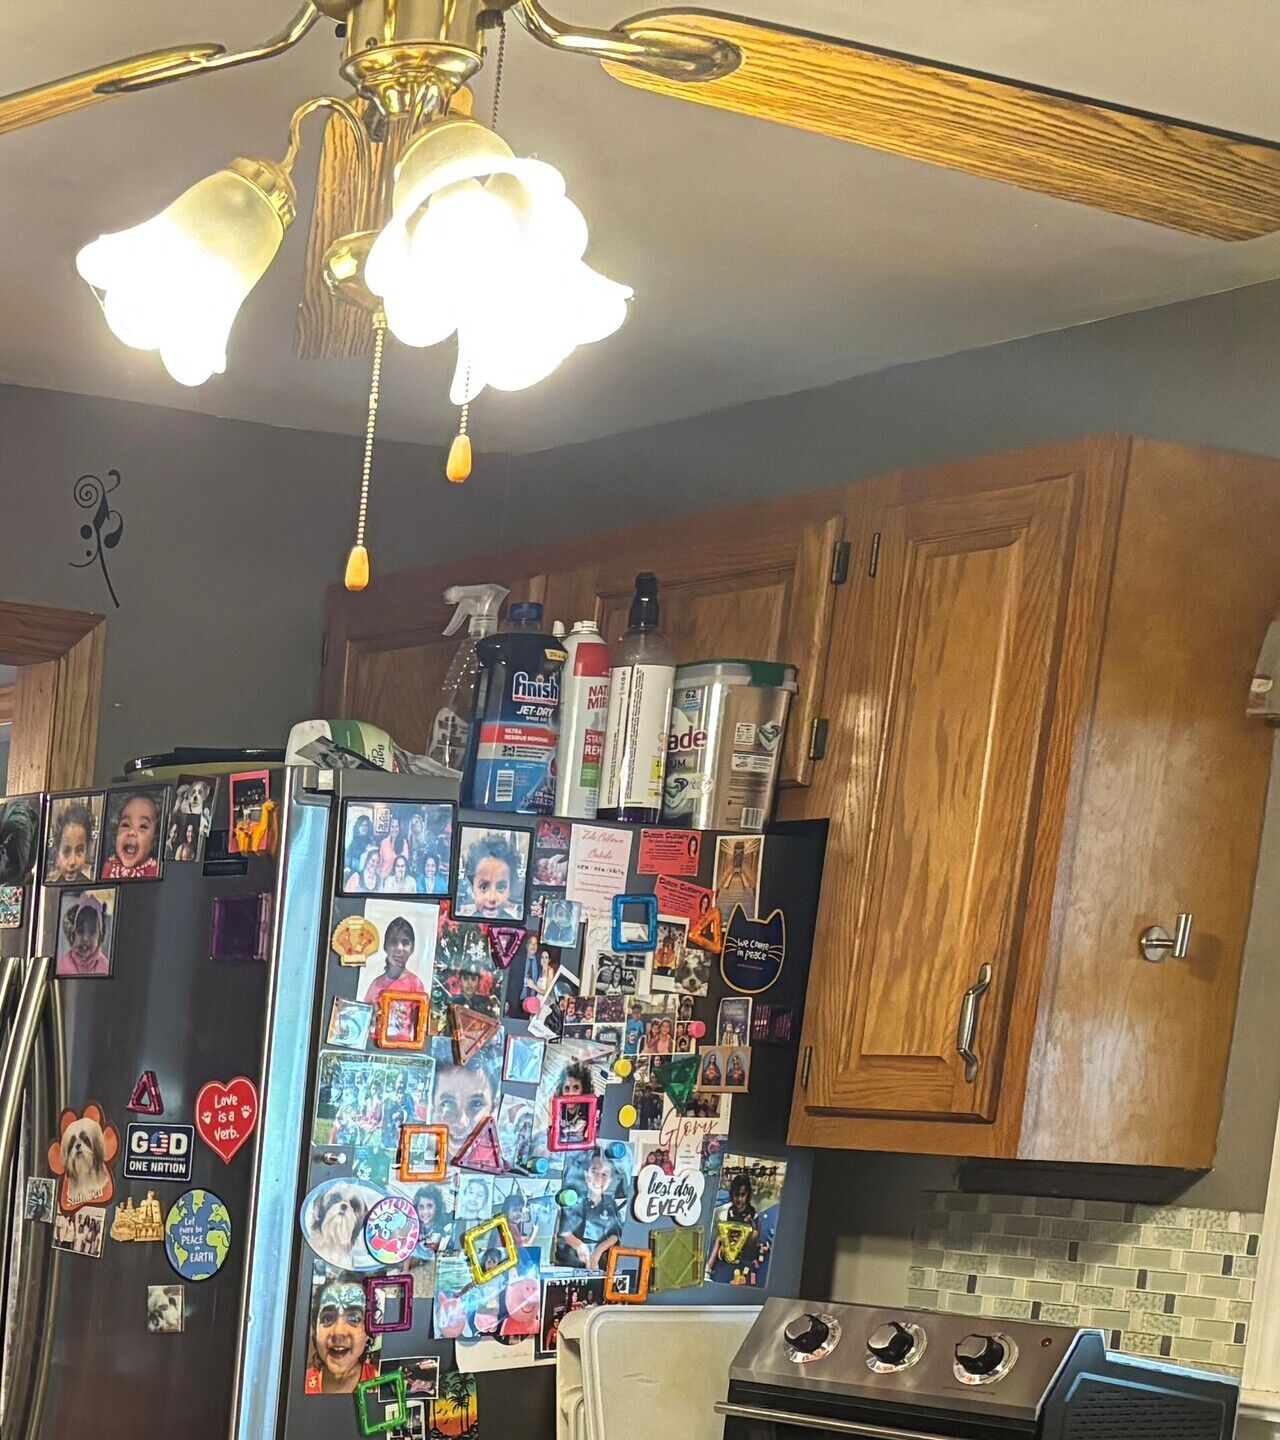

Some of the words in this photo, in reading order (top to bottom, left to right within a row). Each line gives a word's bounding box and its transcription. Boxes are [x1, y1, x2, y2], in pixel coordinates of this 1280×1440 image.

[513, 671, 559, 700] finish
[685, 690, 697, 699] 62
[214, 1094, 238, 1109] Love
[218, 1111, 227, 1123] is
[228, 1111, 235, 1122] a
[131, 1131, 188, 1156] GOD
[129, 1160, 149, 1172] ONE
[150, 1162, 186, 1174] NATION
[647, 1171, 675, 1196] best
[673, 1174, 695, 1204] dog
[181, 1235, 204, 1246] PEACE
[190, 1252, 214, 1263] EARTH
